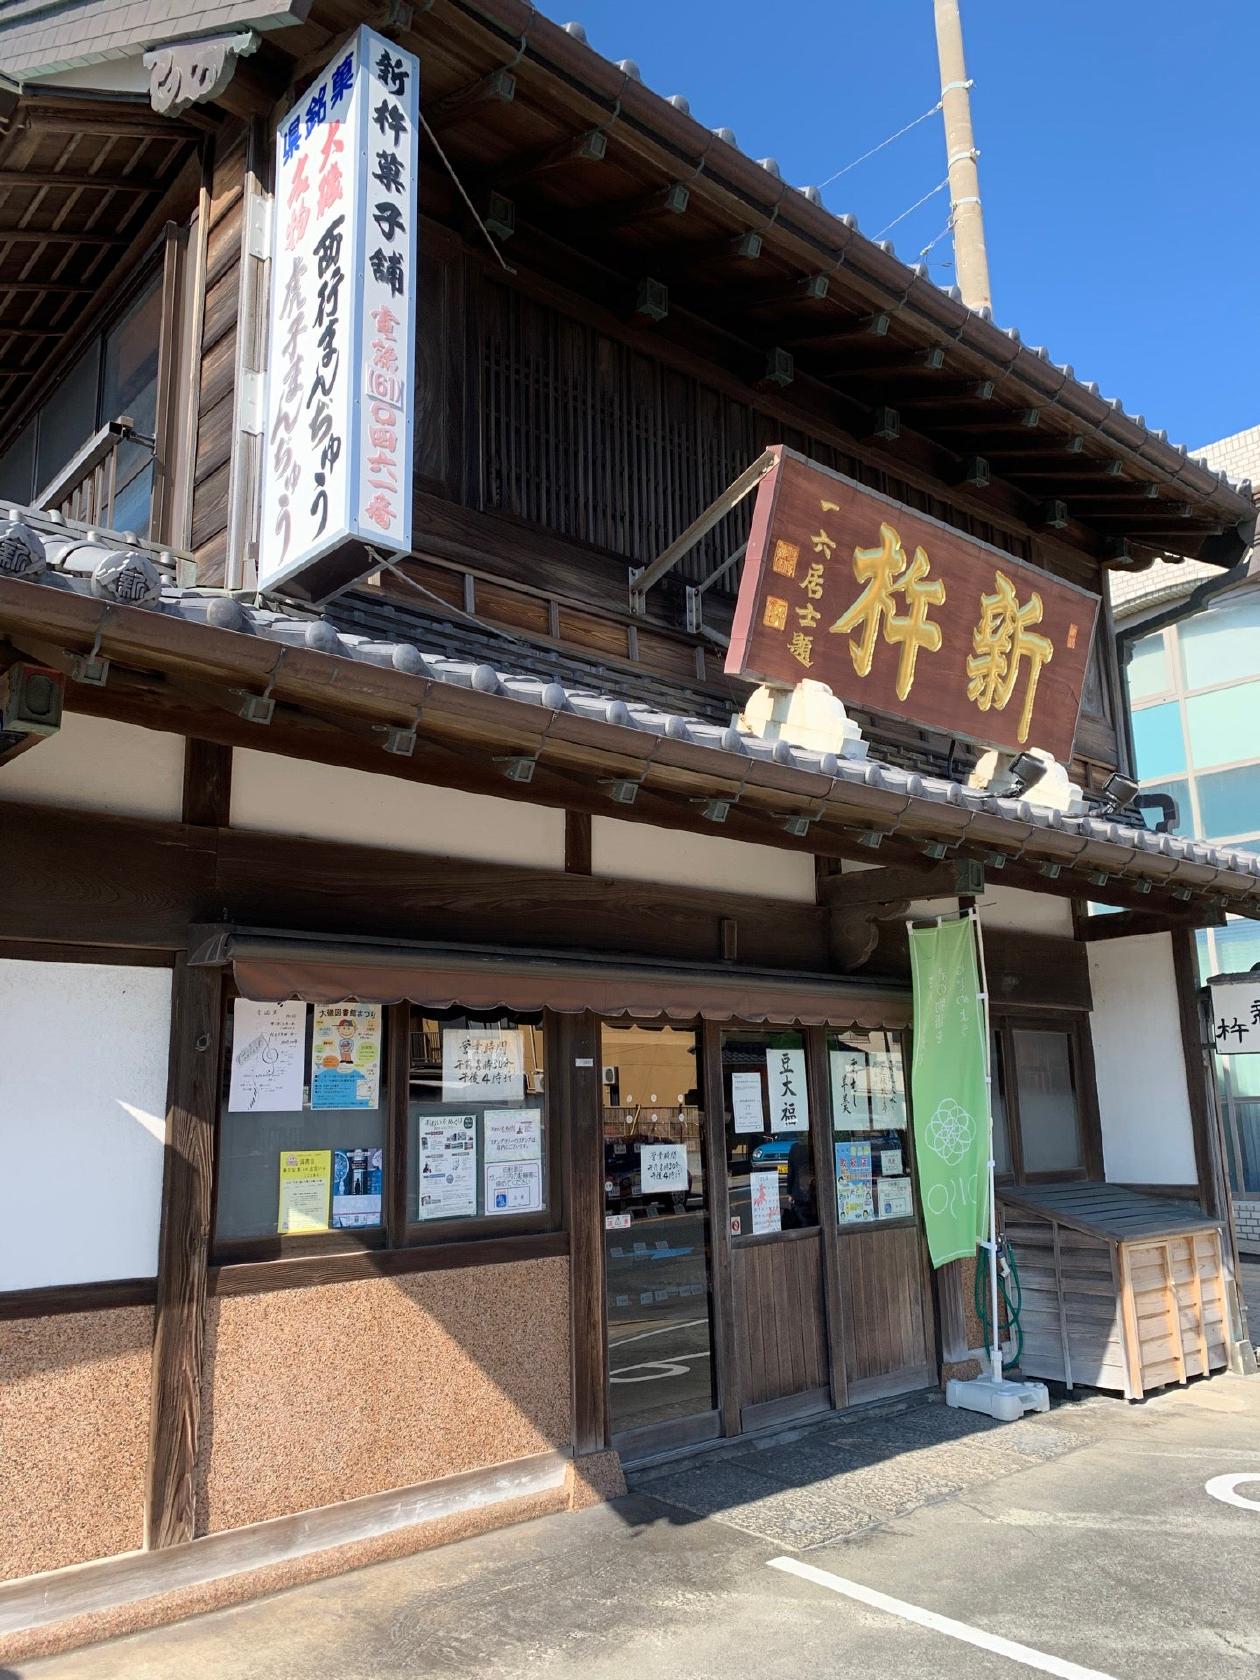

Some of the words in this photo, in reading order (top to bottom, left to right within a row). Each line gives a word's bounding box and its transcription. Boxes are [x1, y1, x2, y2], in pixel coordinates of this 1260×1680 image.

[282, 51, 355, 167] 県銘菓
[369, 48, 410, 298] 新杵菓子舗
[779, 1052, 798, 1127] 豆大福
